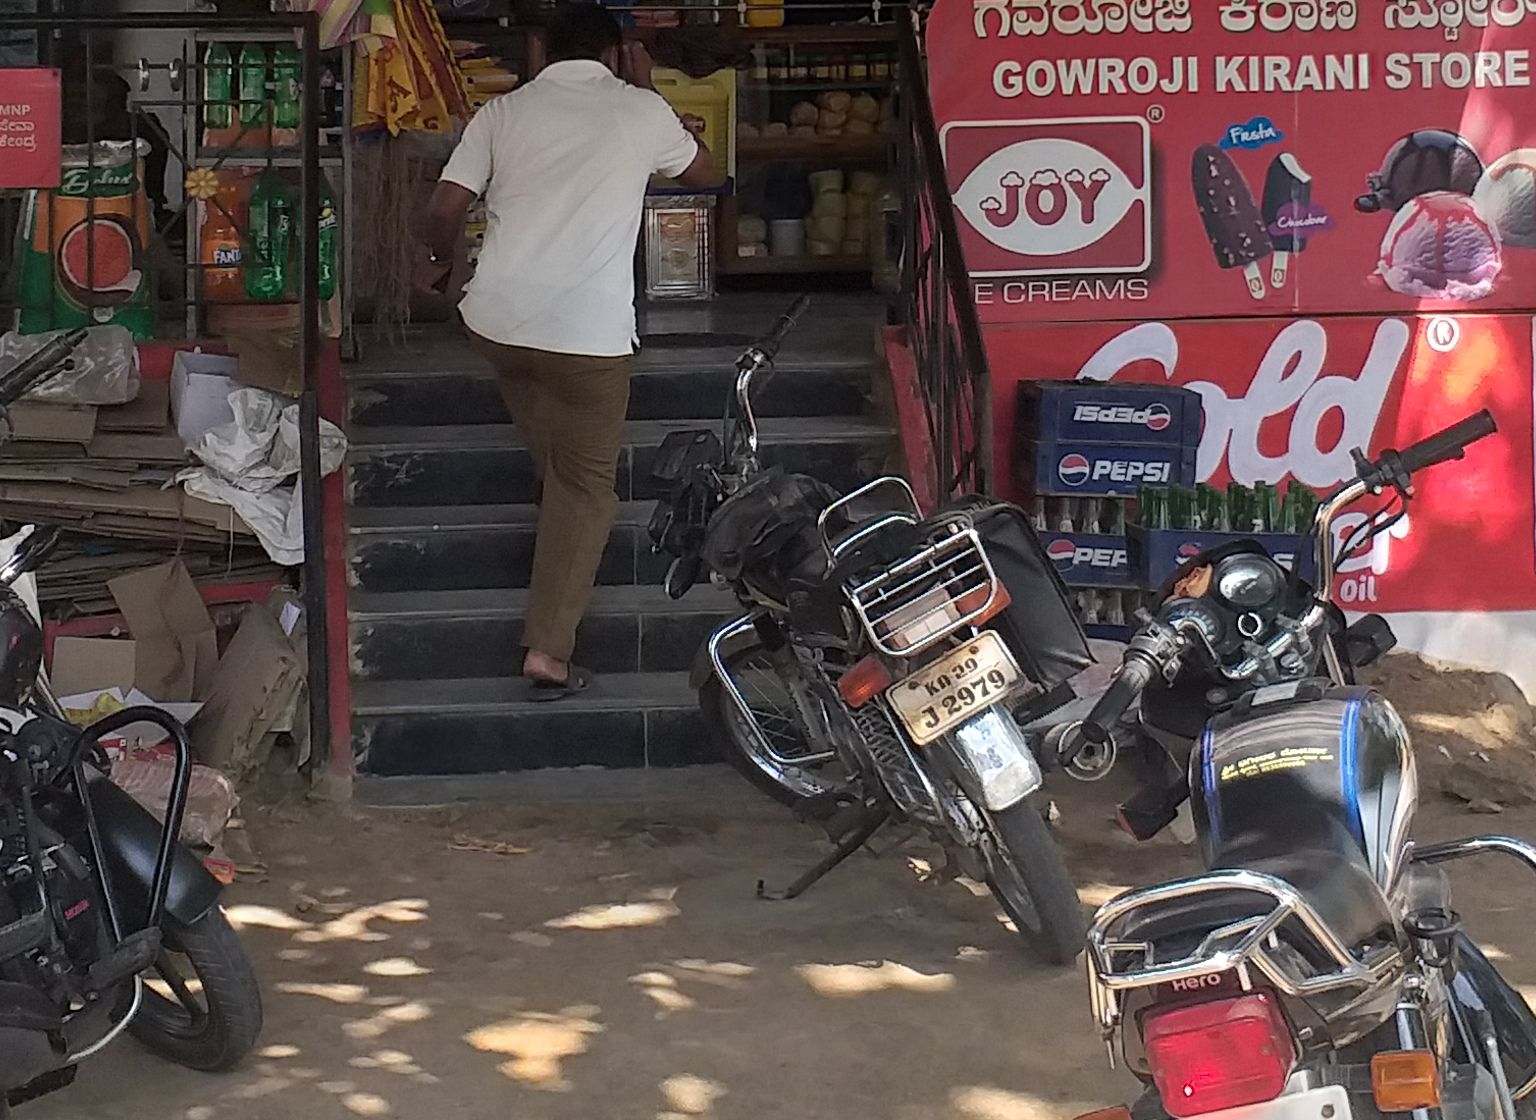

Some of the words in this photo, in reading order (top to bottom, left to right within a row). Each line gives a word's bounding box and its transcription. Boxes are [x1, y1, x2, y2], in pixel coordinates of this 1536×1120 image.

[993, 55, 1199, 99] GOWROJI
[1214, 53, 1370, 94] KIRANI
[1384, 49, 1531, 90] STORE
[979, 168, 1111, 228] JOY
[1002, 278, 1149, 303] CREAMS
[1073, 405, 1151, 424] PEPSI
[1091, 459, 1170, 483] PEPSI
[1072, 547, 1128, 568] PEP
[941, 669, 1007, 715] 2979
[1172, 973, 1222, 992] Hero
